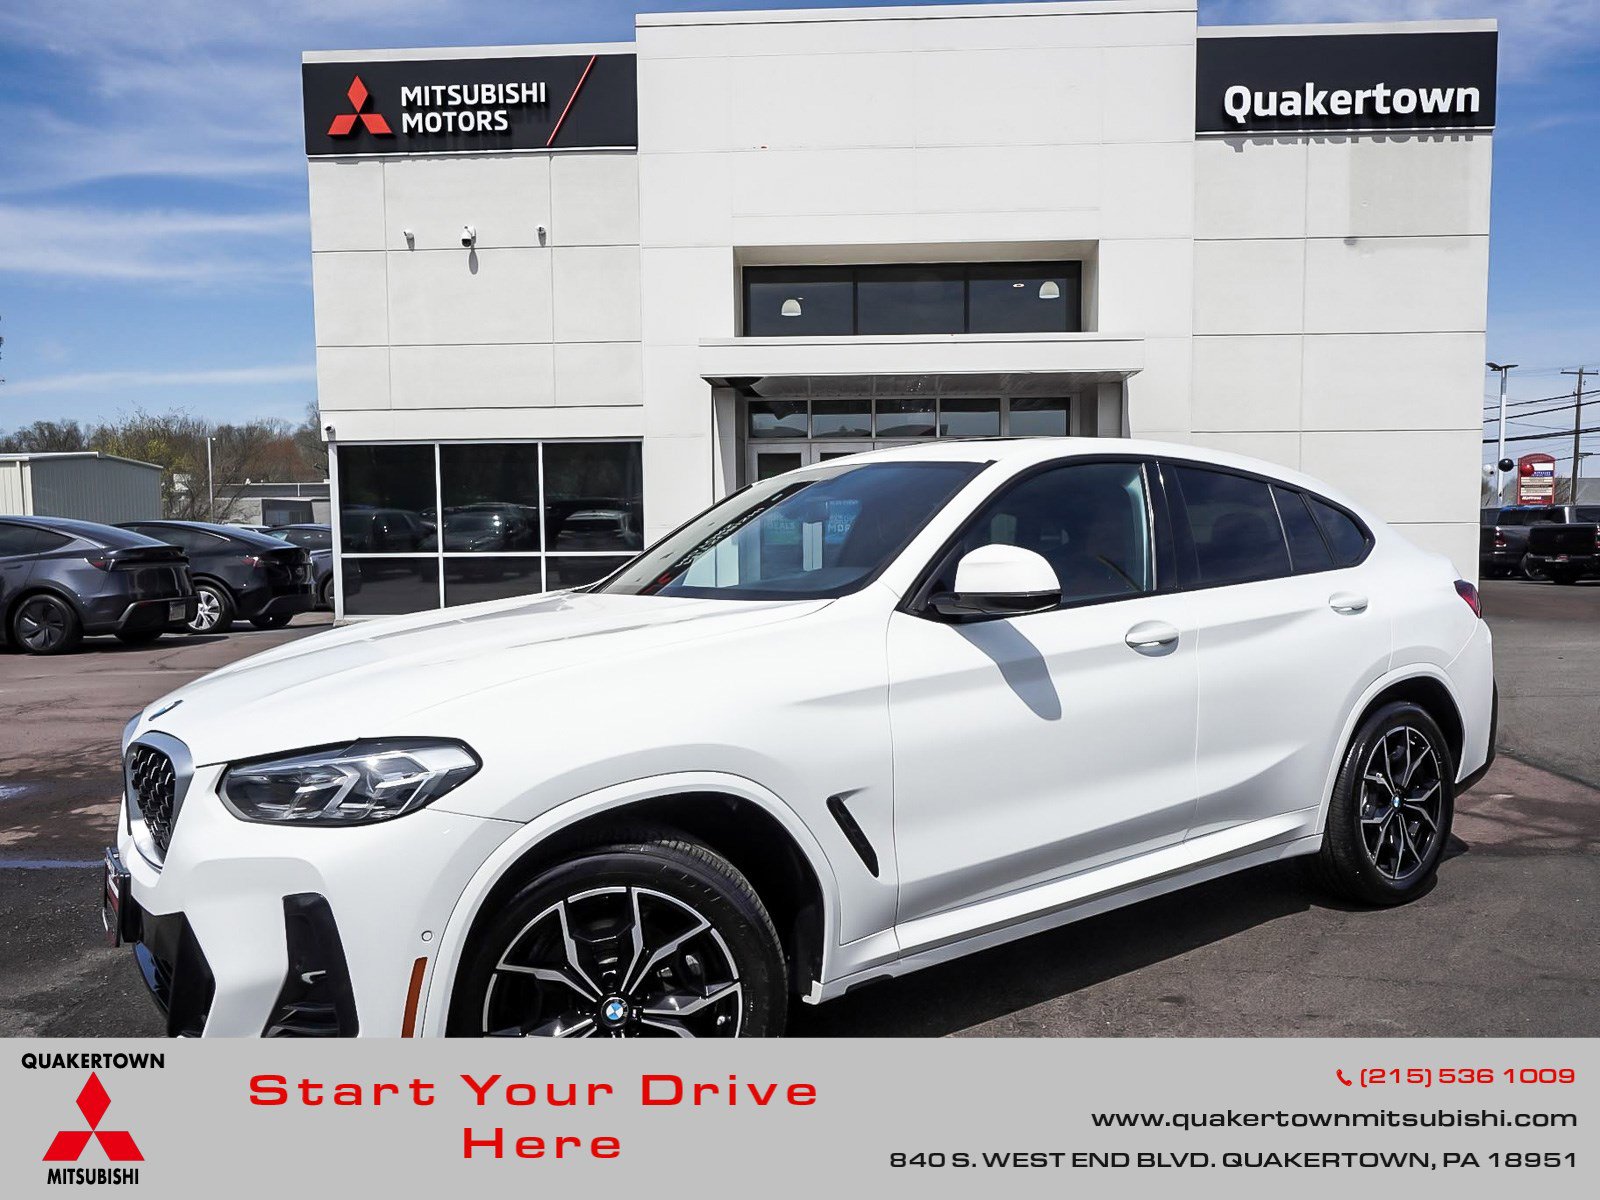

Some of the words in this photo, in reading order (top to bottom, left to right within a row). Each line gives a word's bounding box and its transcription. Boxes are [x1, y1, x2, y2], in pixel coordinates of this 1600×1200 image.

[401, 81, 547, 107] MITSUBISHI
[1223, 82, 1481, 124] Quakertown
[402, 109, 509, 134] MOTORS
